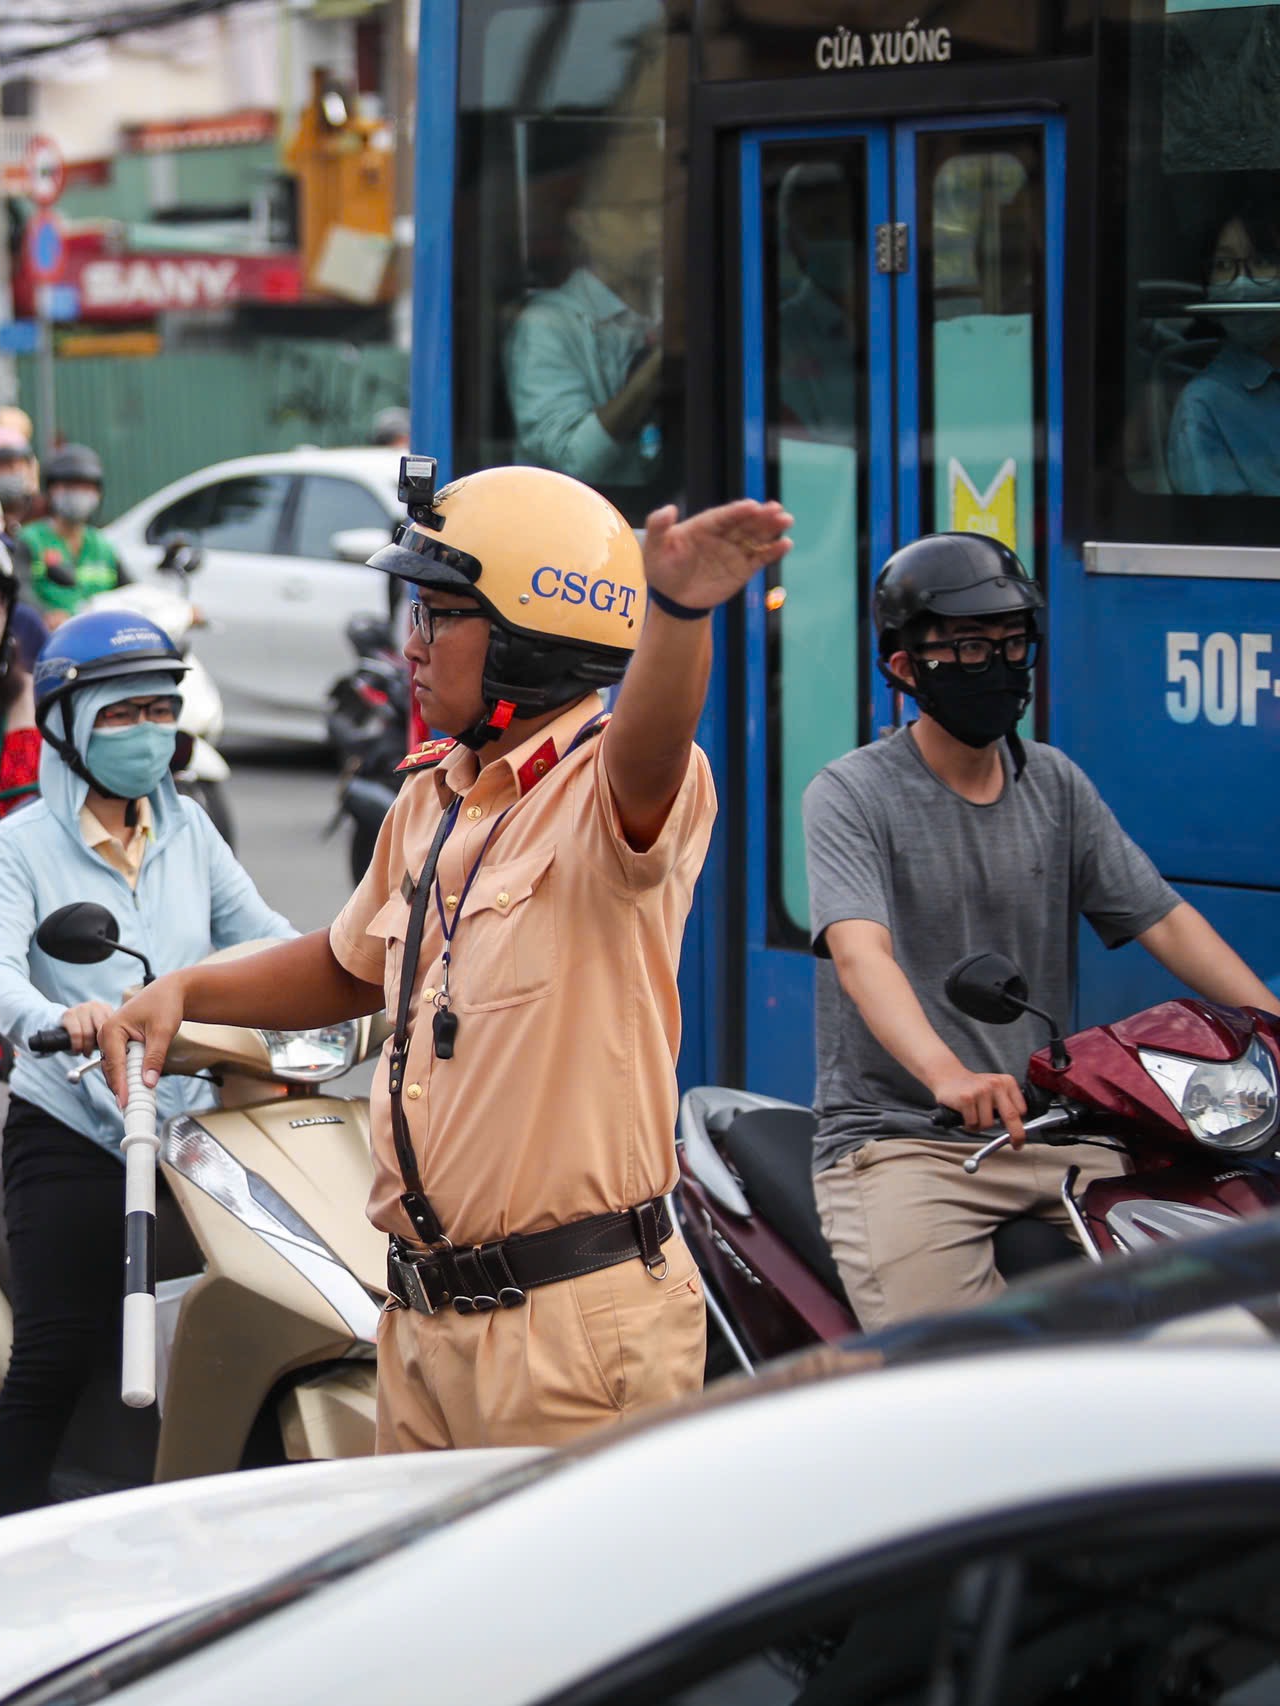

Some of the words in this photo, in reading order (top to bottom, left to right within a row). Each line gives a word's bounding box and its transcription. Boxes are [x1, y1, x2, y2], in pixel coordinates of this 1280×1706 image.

[816, 25, 864, 70] CỬA
[869, 17, 952, 66] XUỐNG
[82, 258, 238, 308] SANY
[531, 566, 637, 618] CSGT
[289, 1115, 345, 1129] HONDA
